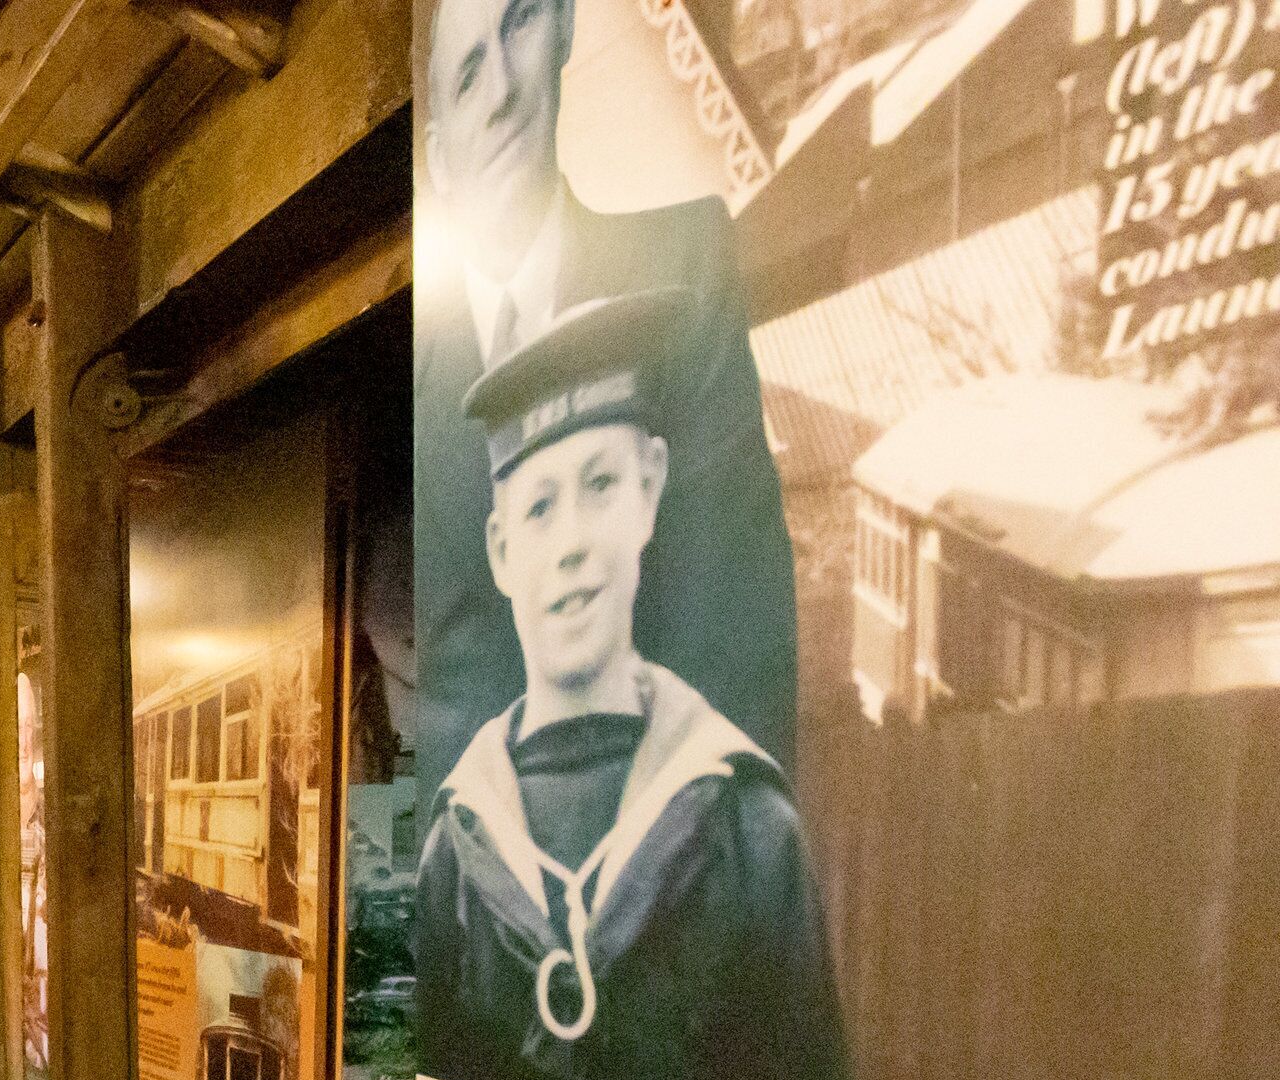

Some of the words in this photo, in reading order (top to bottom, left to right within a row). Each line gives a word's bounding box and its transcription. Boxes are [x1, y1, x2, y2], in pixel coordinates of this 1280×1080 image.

[1106, 3, 1256, 114] (left)
[1105, 114, 1163, 170] in
[1175, 68, 1276, 140] the
[1104, 160, 1176, 234] 15
[1176, 134, 1280, 220] yea
[1100, 200, 1280, 297] condu
